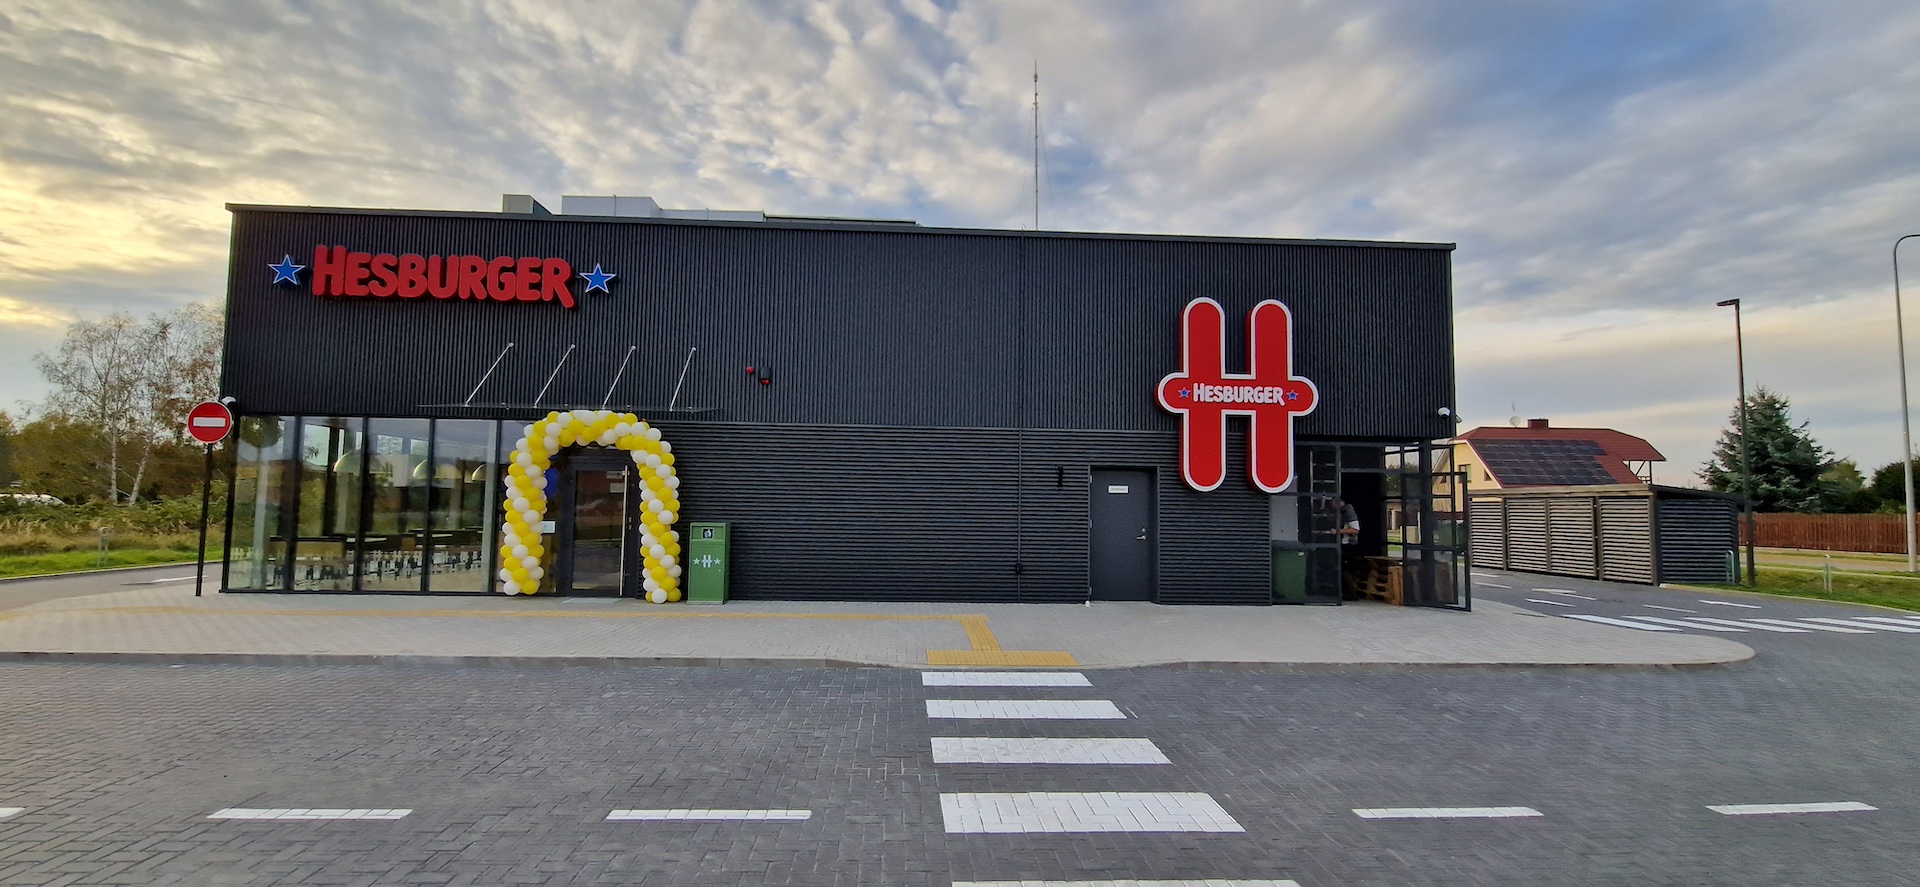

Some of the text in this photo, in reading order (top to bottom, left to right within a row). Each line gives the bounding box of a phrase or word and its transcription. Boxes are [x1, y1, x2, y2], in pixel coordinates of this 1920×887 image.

[312, 245, 575, 308] HESBURGER
[1157, 297, 1319, 493] H
[1193, 383, 1285, 406] HESBURGER
